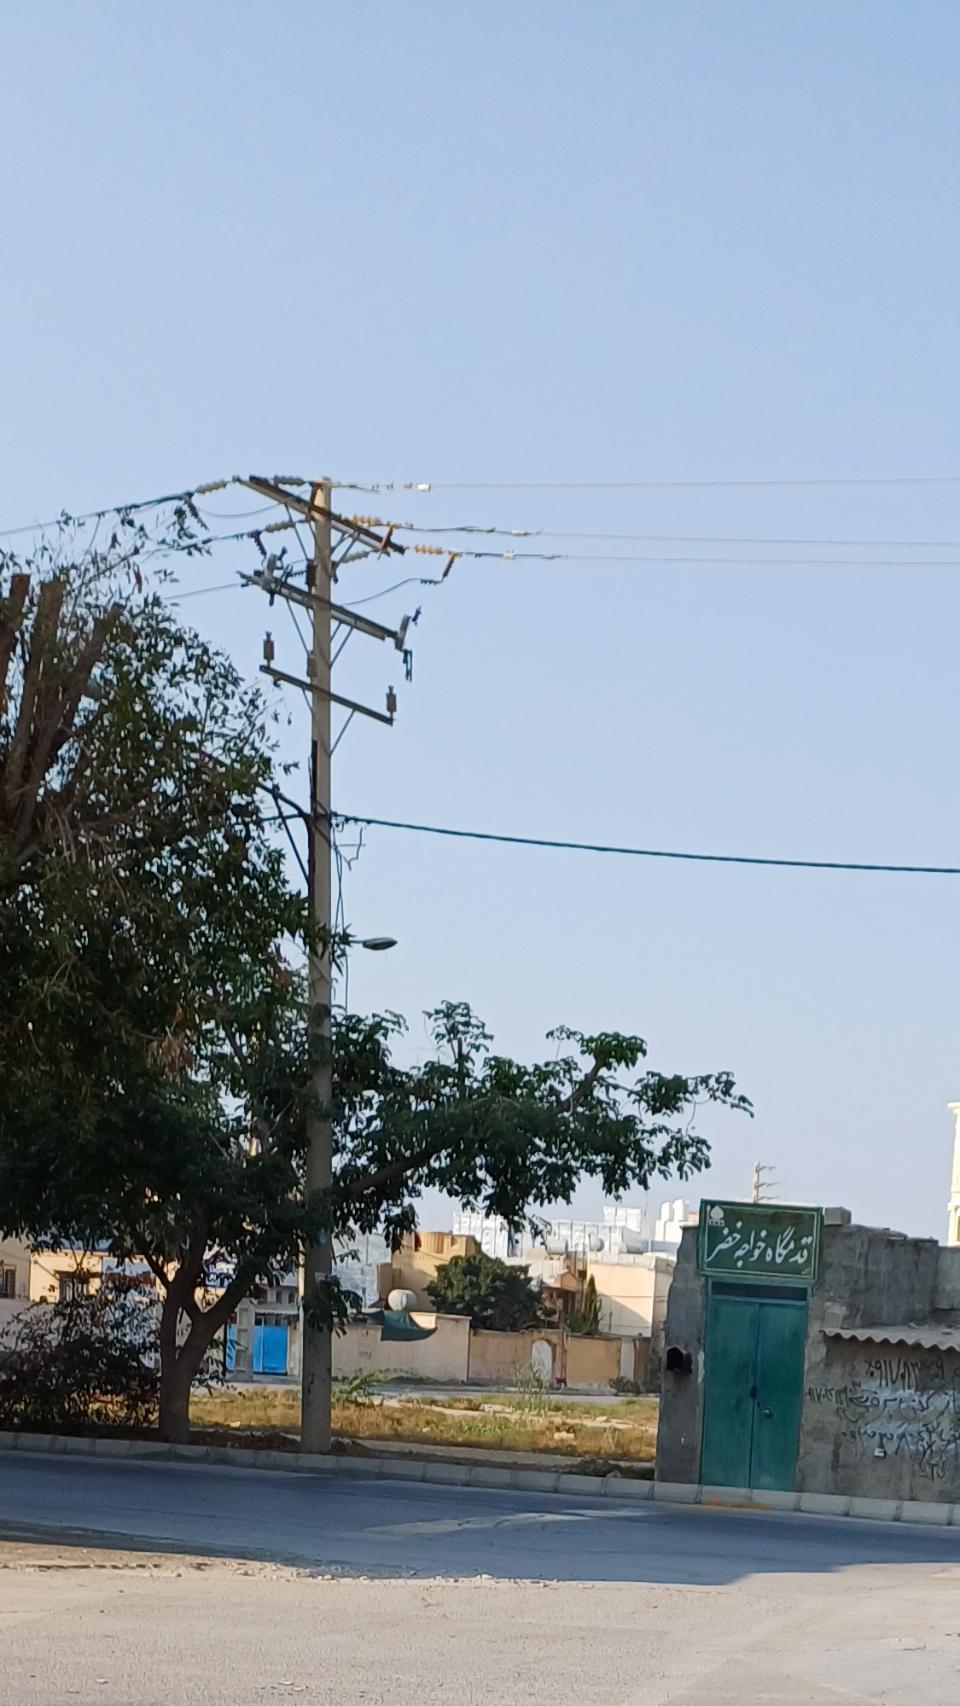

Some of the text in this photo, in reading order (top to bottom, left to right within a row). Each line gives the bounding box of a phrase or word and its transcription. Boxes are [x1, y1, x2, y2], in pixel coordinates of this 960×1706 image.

[705, 1220, 813, 1268] قدمگاه خواجه خضر
